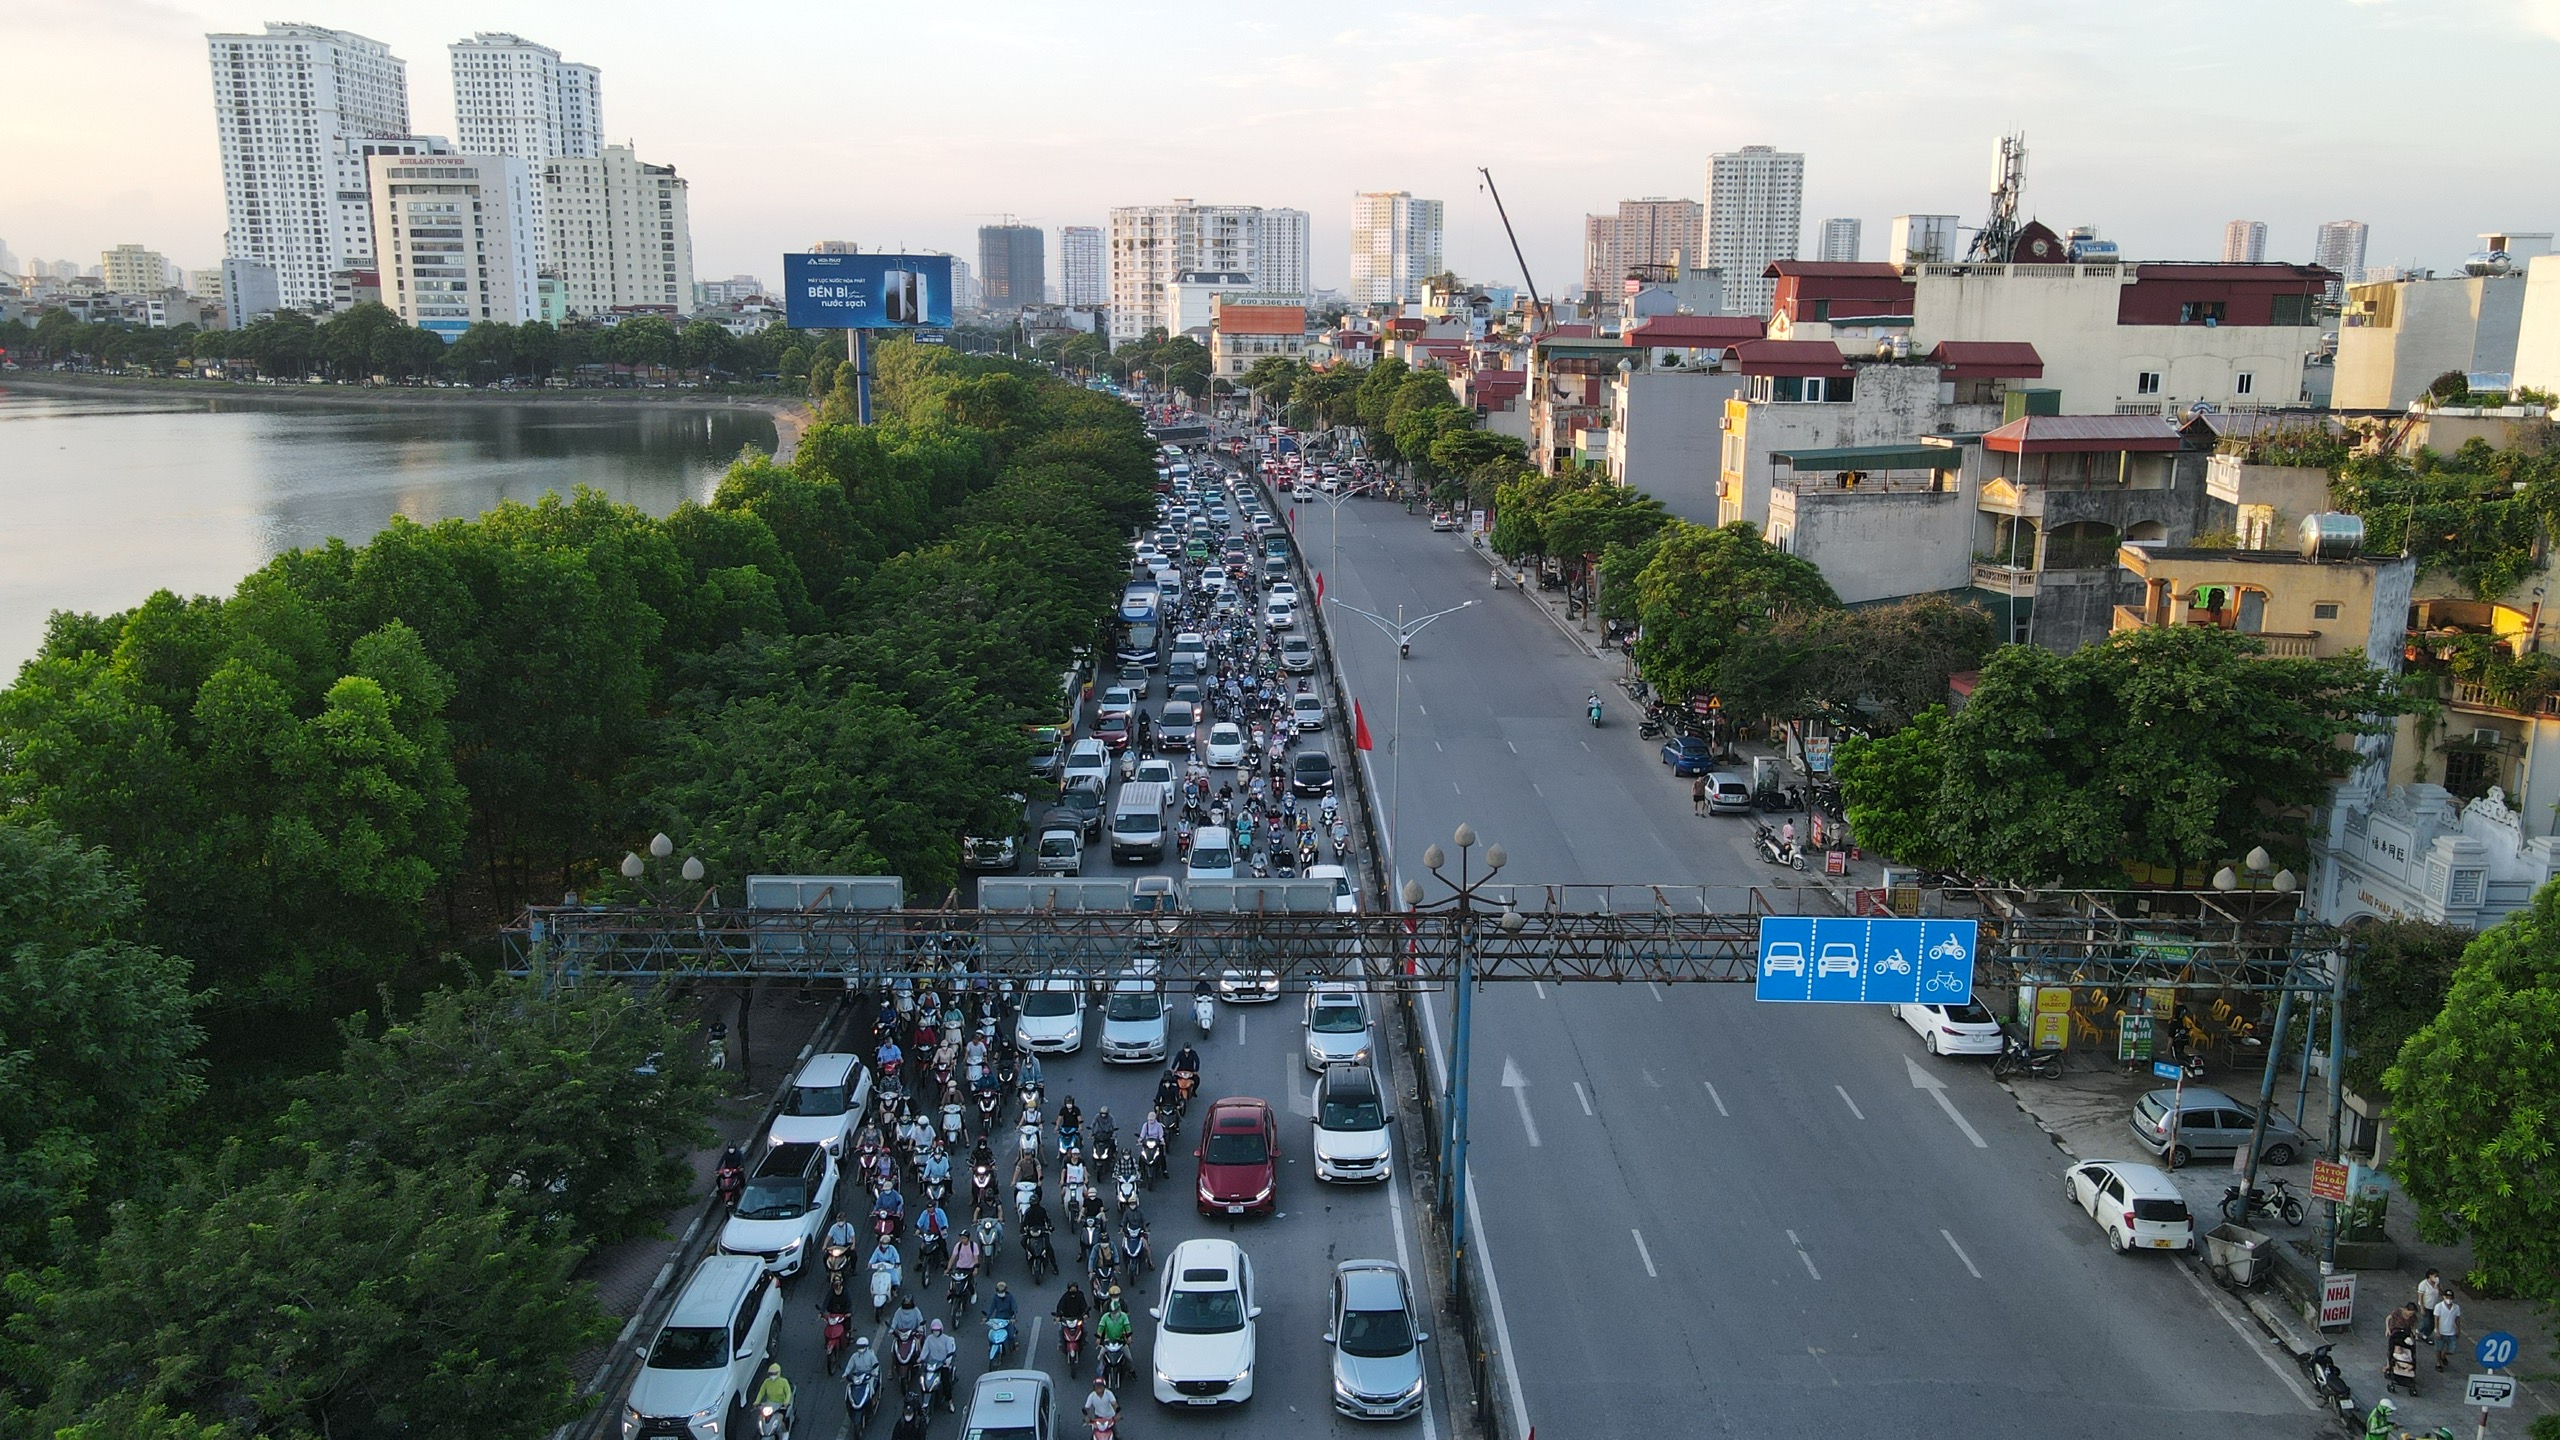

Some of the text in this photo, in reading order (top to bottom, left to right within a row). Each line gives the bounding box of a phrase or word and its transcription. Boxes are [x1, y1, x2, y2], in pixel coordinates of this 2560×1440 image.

[845, 299, 867, 309] sạch
[2327, 1284, 2351, 1302] NHÀ
[2322, 1301, 2352, 1322] NGHỈ
[2482, 1339, 2512, 1363] 20
